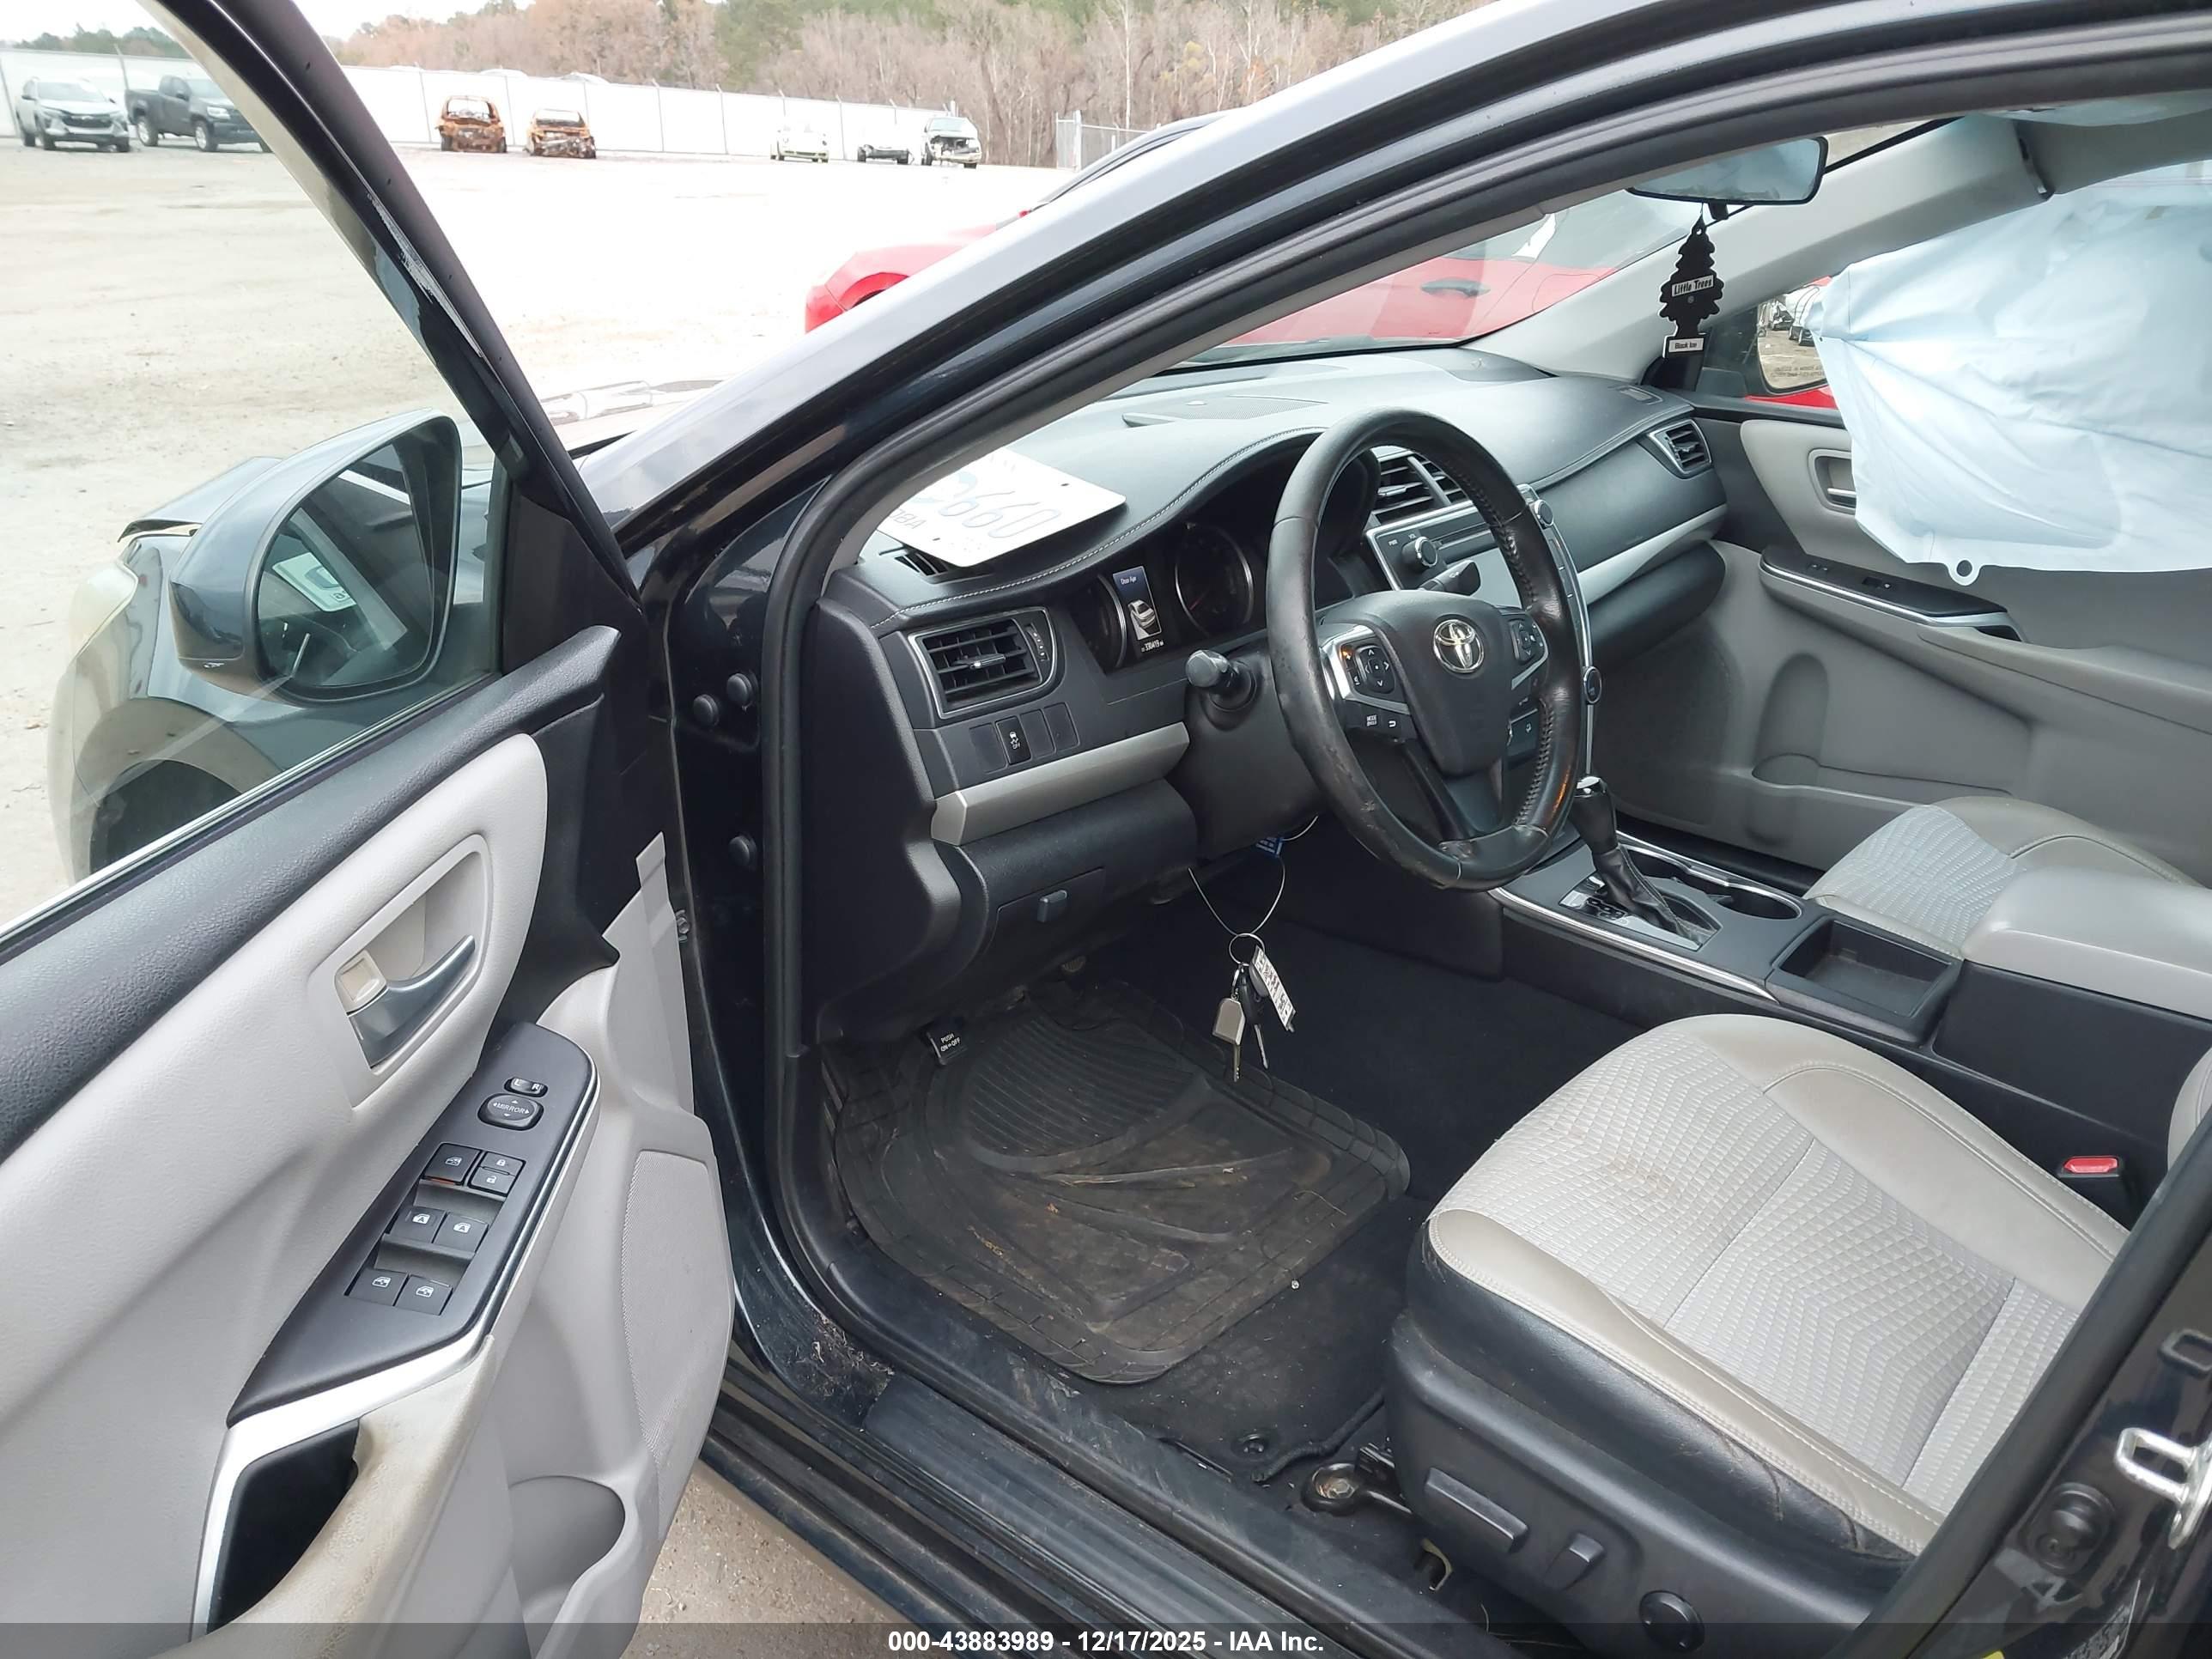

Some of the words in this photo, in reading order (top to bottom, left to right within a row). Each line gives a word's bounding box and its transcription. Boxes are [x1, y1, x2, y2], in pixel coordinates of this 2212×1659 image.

[1674, 283, 1692, 295] Little
[1694, 278, 1712, 290] Trees
[940, 1032, 955, 1044] PUSH
[514, 1078, 521, 1087] L
[495, 1102, 526, 1115] MIRROR
